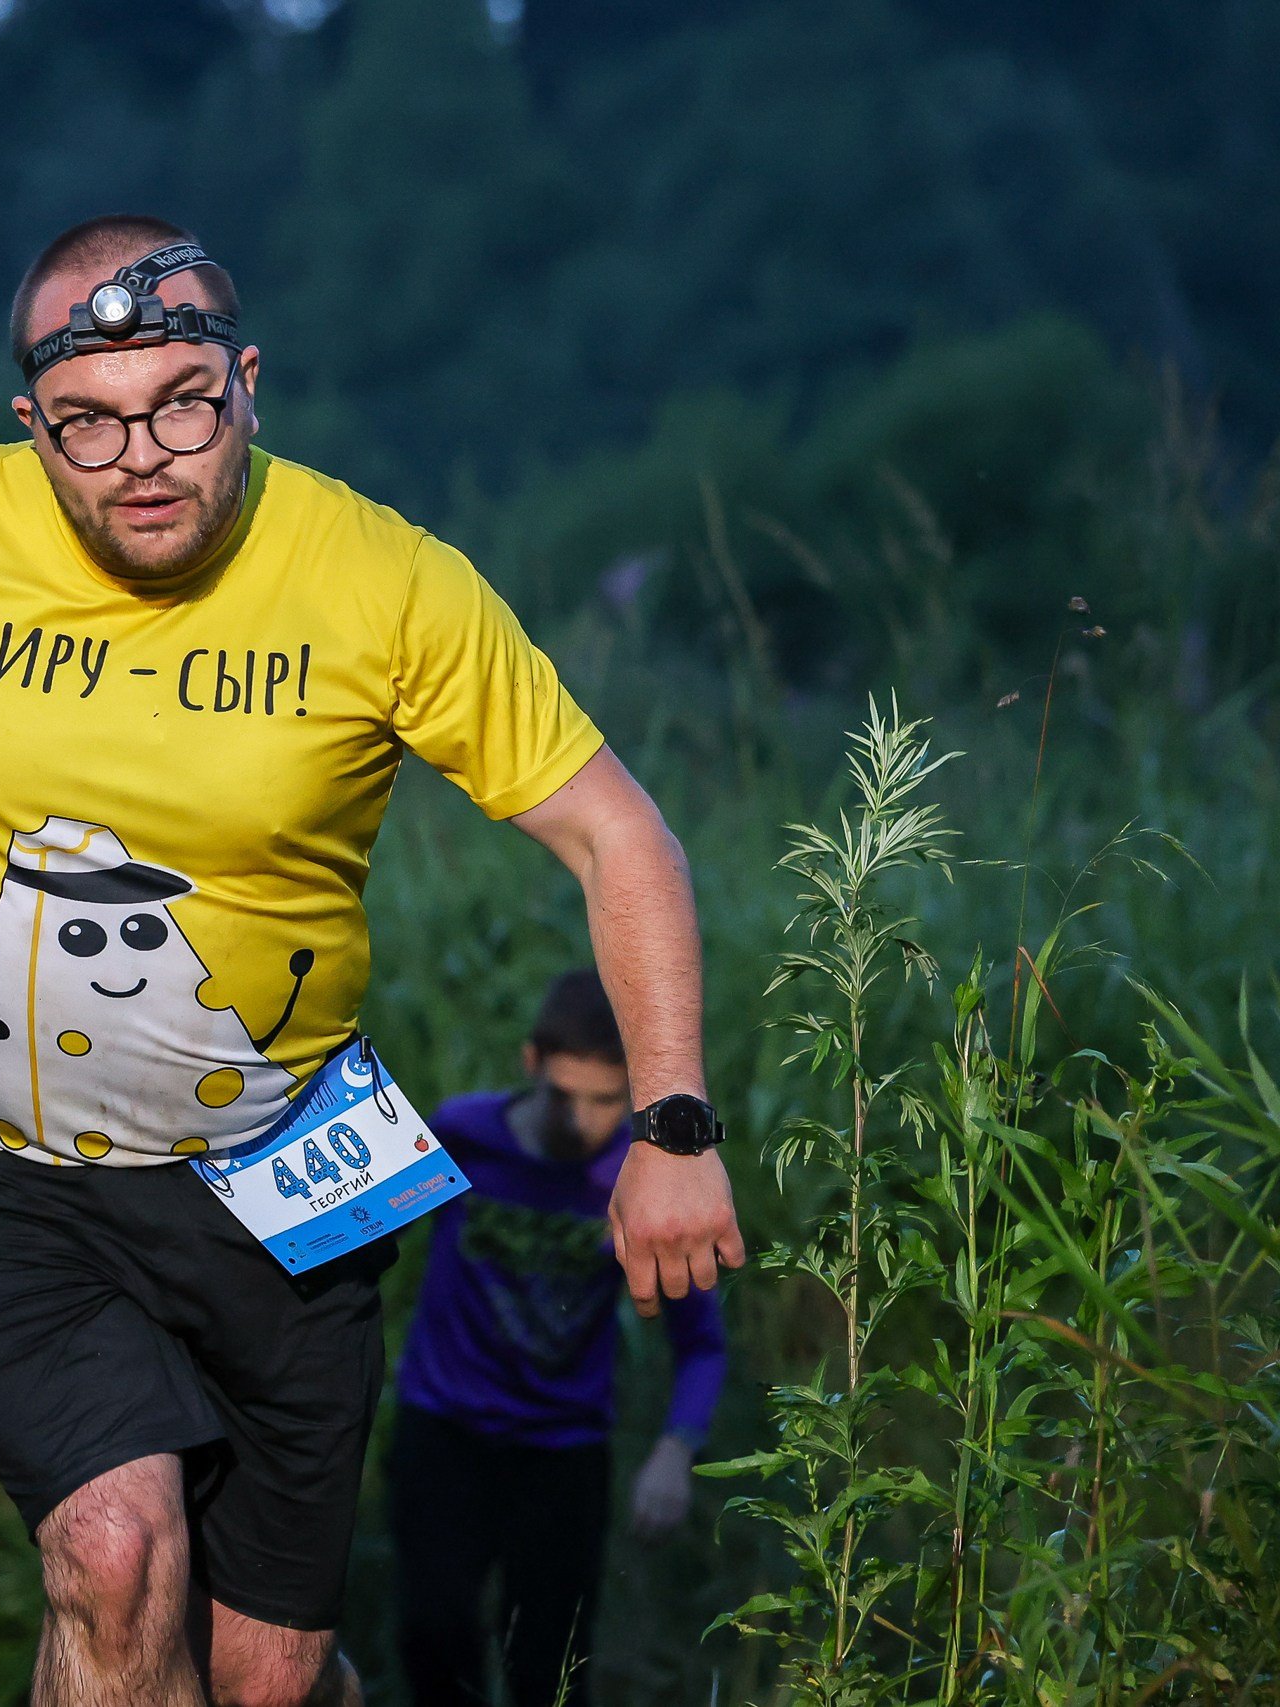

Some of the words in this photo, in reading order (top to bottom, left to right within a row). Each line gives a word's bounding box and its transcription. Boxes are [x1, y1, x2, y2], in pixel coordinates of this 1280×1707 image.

[32, 331, 74, 366] Navg
[271, 1122, 372, 1199] 440
[309, 1168, 375, 1212] ГЕОРГИЙ
